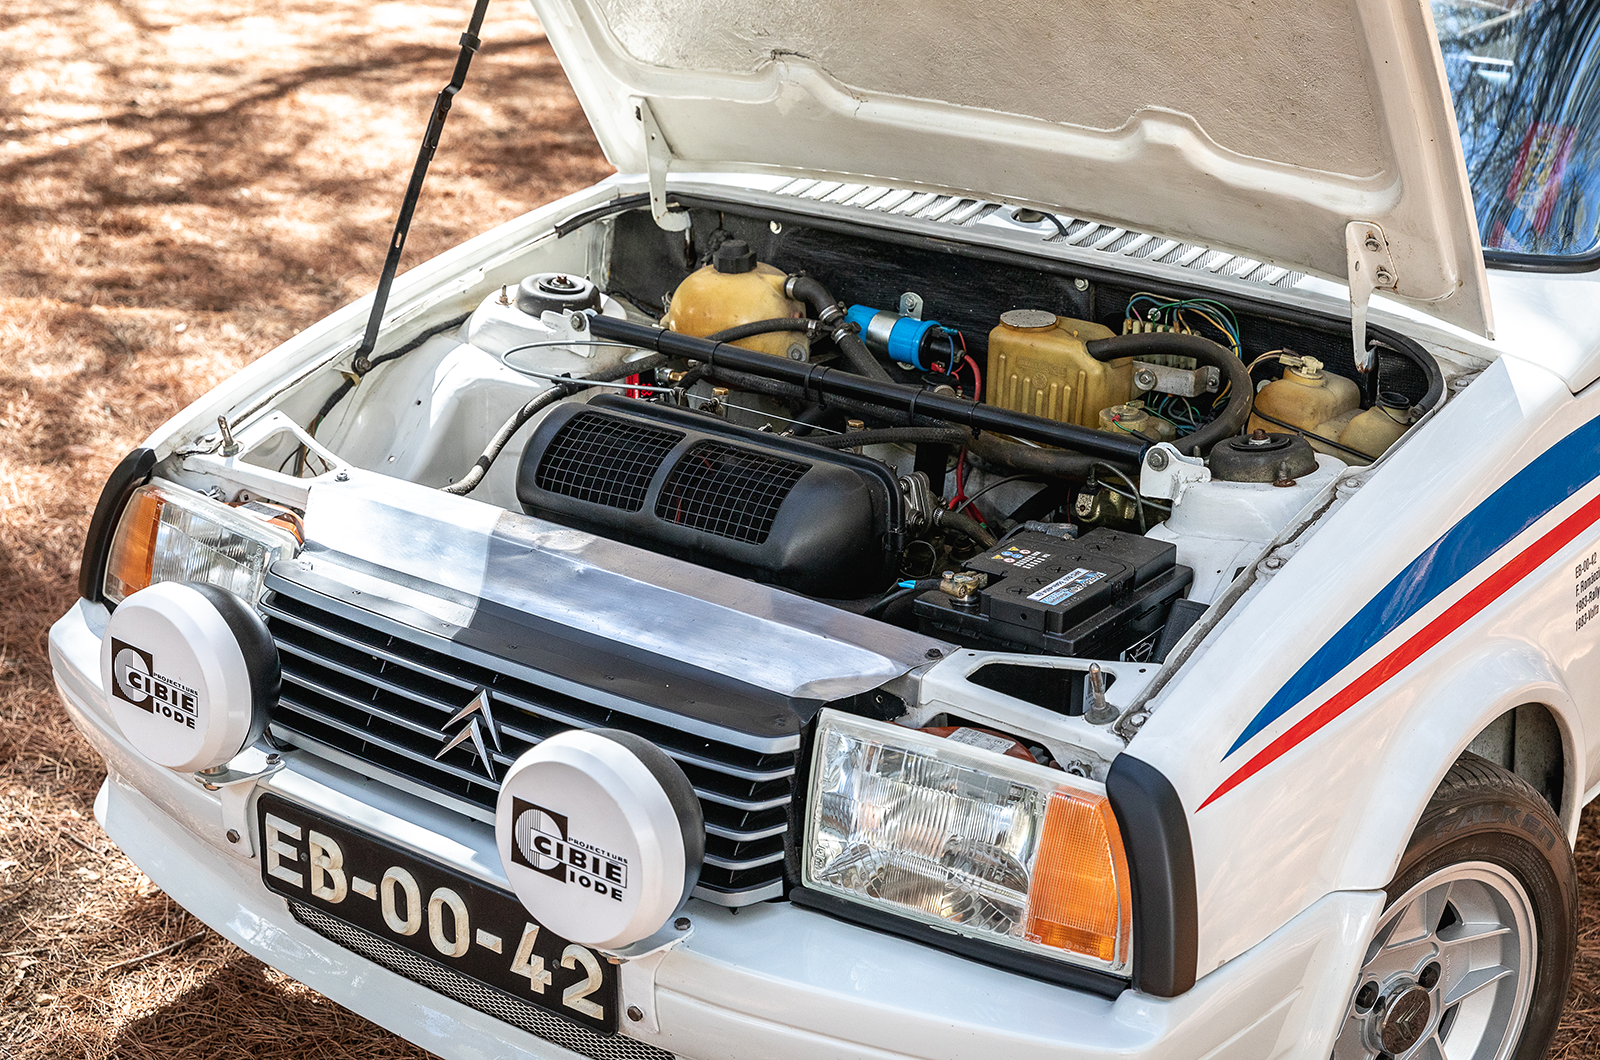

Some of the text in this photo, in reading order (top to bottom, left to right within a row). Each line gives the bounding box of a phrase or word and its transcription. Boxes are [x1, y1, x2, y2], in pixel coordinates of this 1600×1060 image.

[153, 672, 199, 696] PROJECTEURS
[155, 702, 196, 730] IODE
[568, 836, 628, 864] PROJECTEURS
[569, 870, 623, 902] IODE
[265, 812, 604, 1021] EB-00-42
